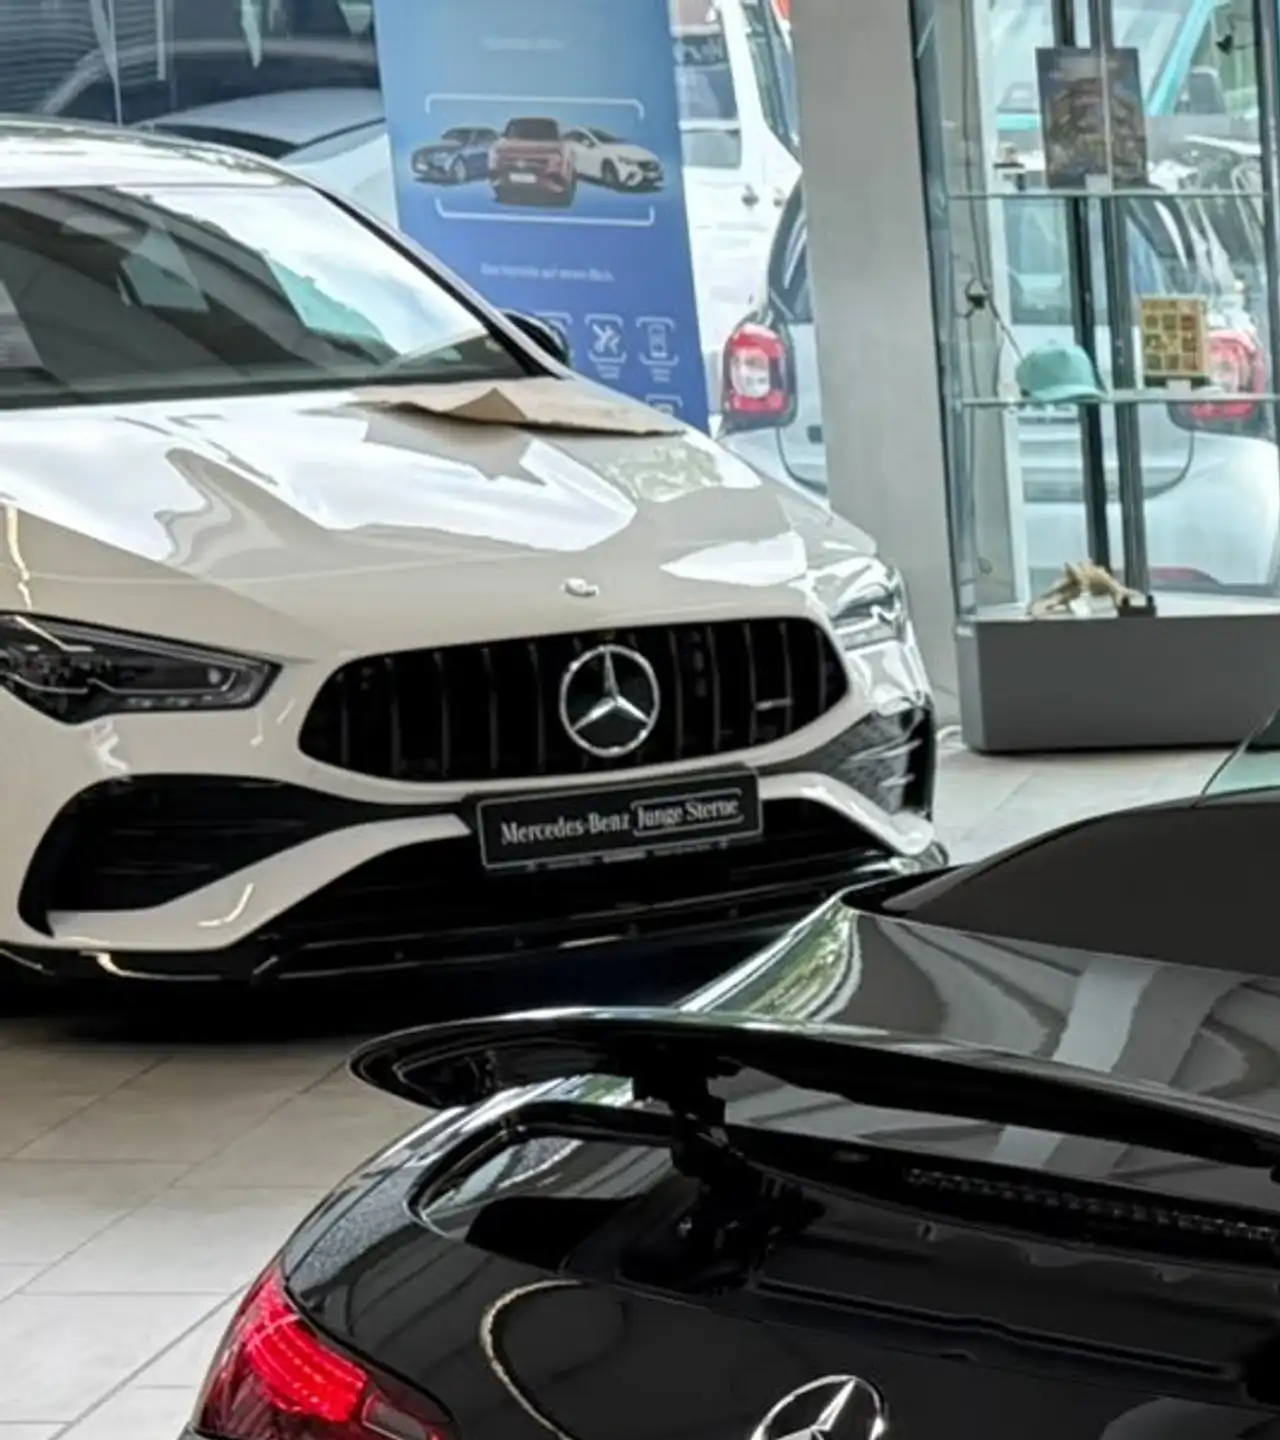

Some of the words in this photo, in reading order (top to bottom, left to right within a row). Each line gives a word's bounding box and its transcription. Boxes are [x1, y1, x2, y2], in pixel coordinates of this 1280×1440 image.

[500, 811, 631, 846] Mercedes-Benz
[637, 805, 684, 830] Junge
[684, 798, 740, 821] Sterne
